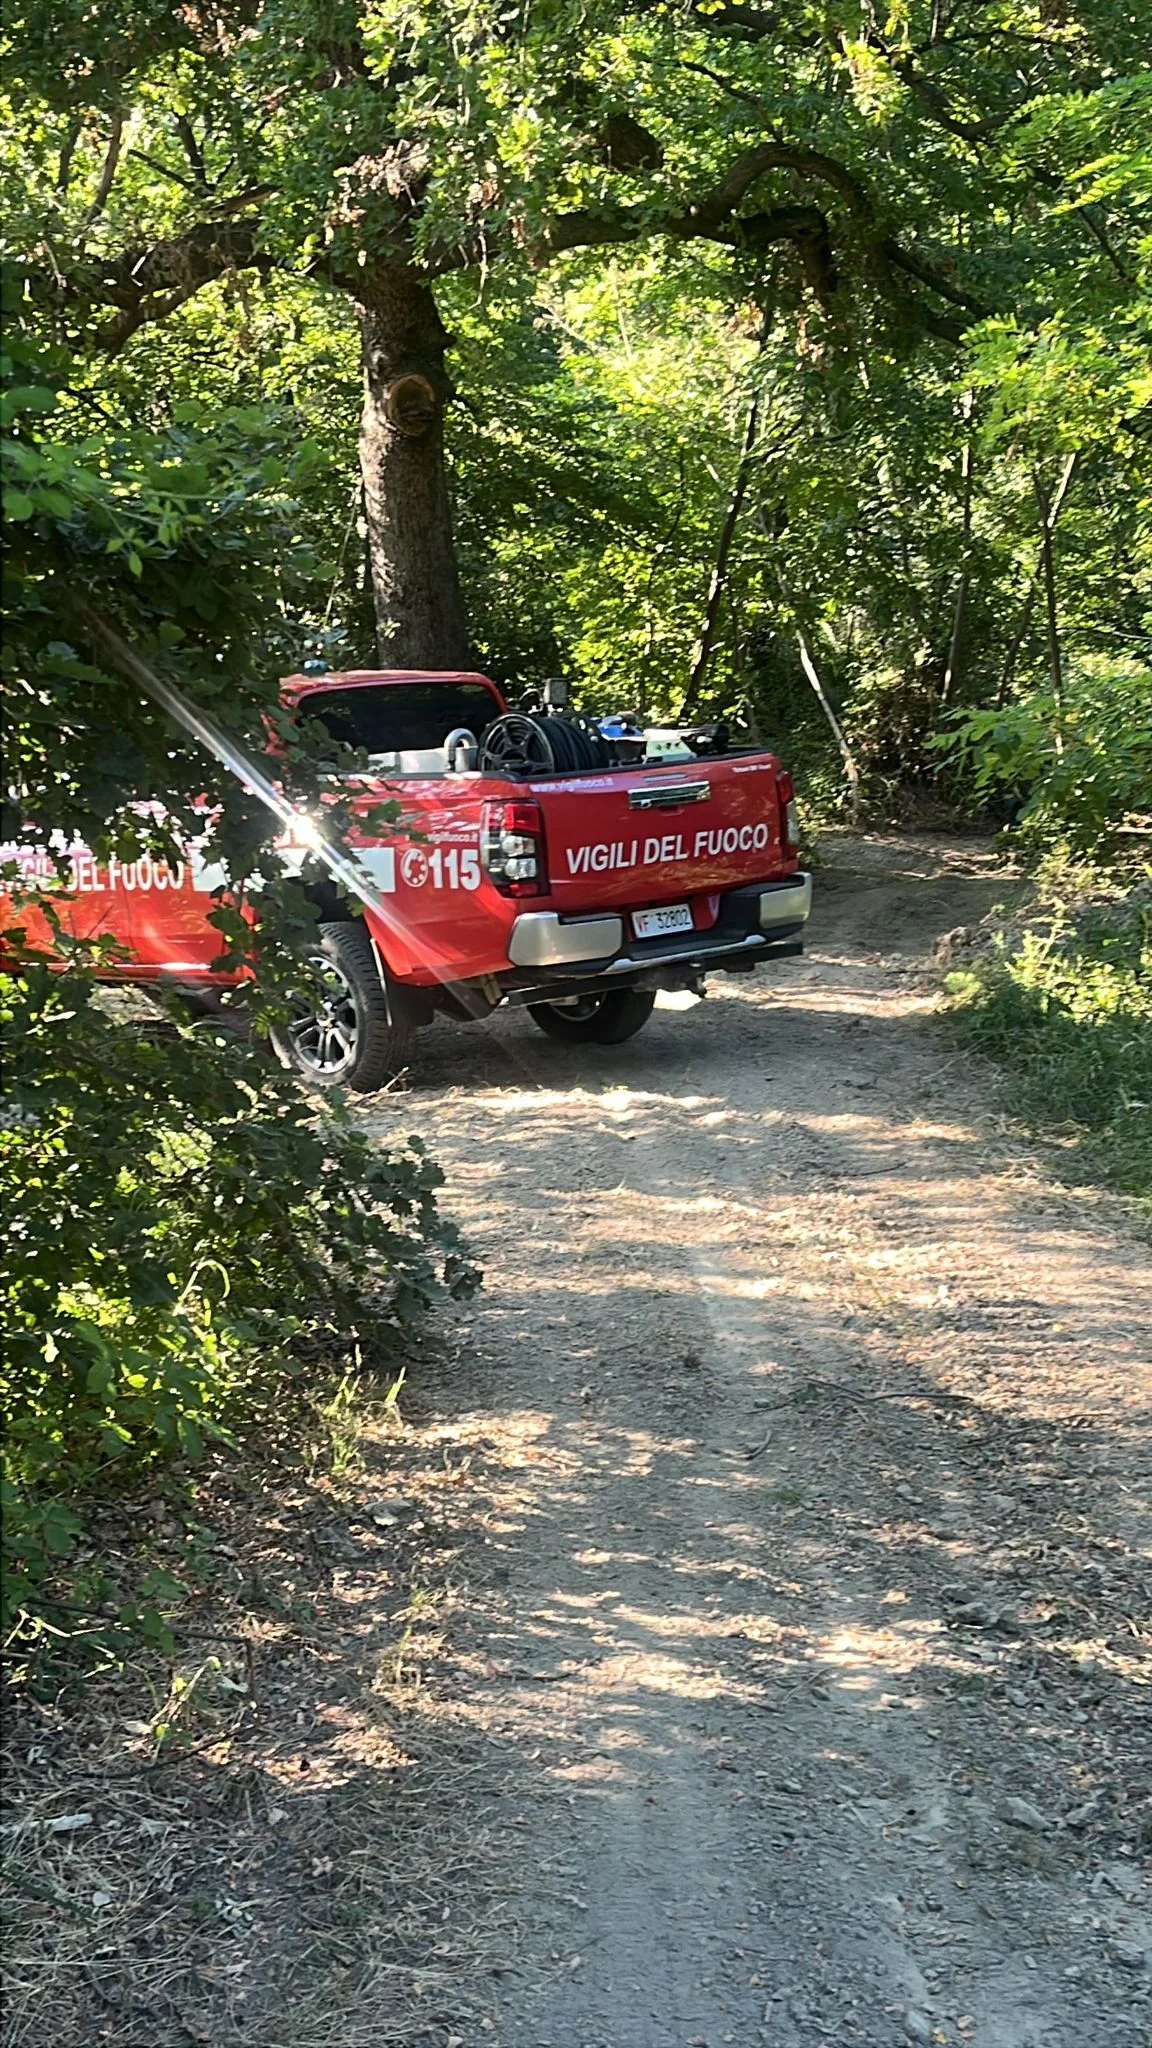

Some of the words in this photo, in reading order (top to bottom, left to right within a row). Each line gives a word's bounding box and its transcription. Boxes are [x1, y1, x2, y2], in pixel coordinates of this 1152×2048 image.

[428, 848, 481, 891] 115
[566, 840, 637, 874] VIGILI
[644, 834, 688, 865] DEL
[694, 823, 769, 857] FUOCO
[655, 908, 691, 929] 32802
